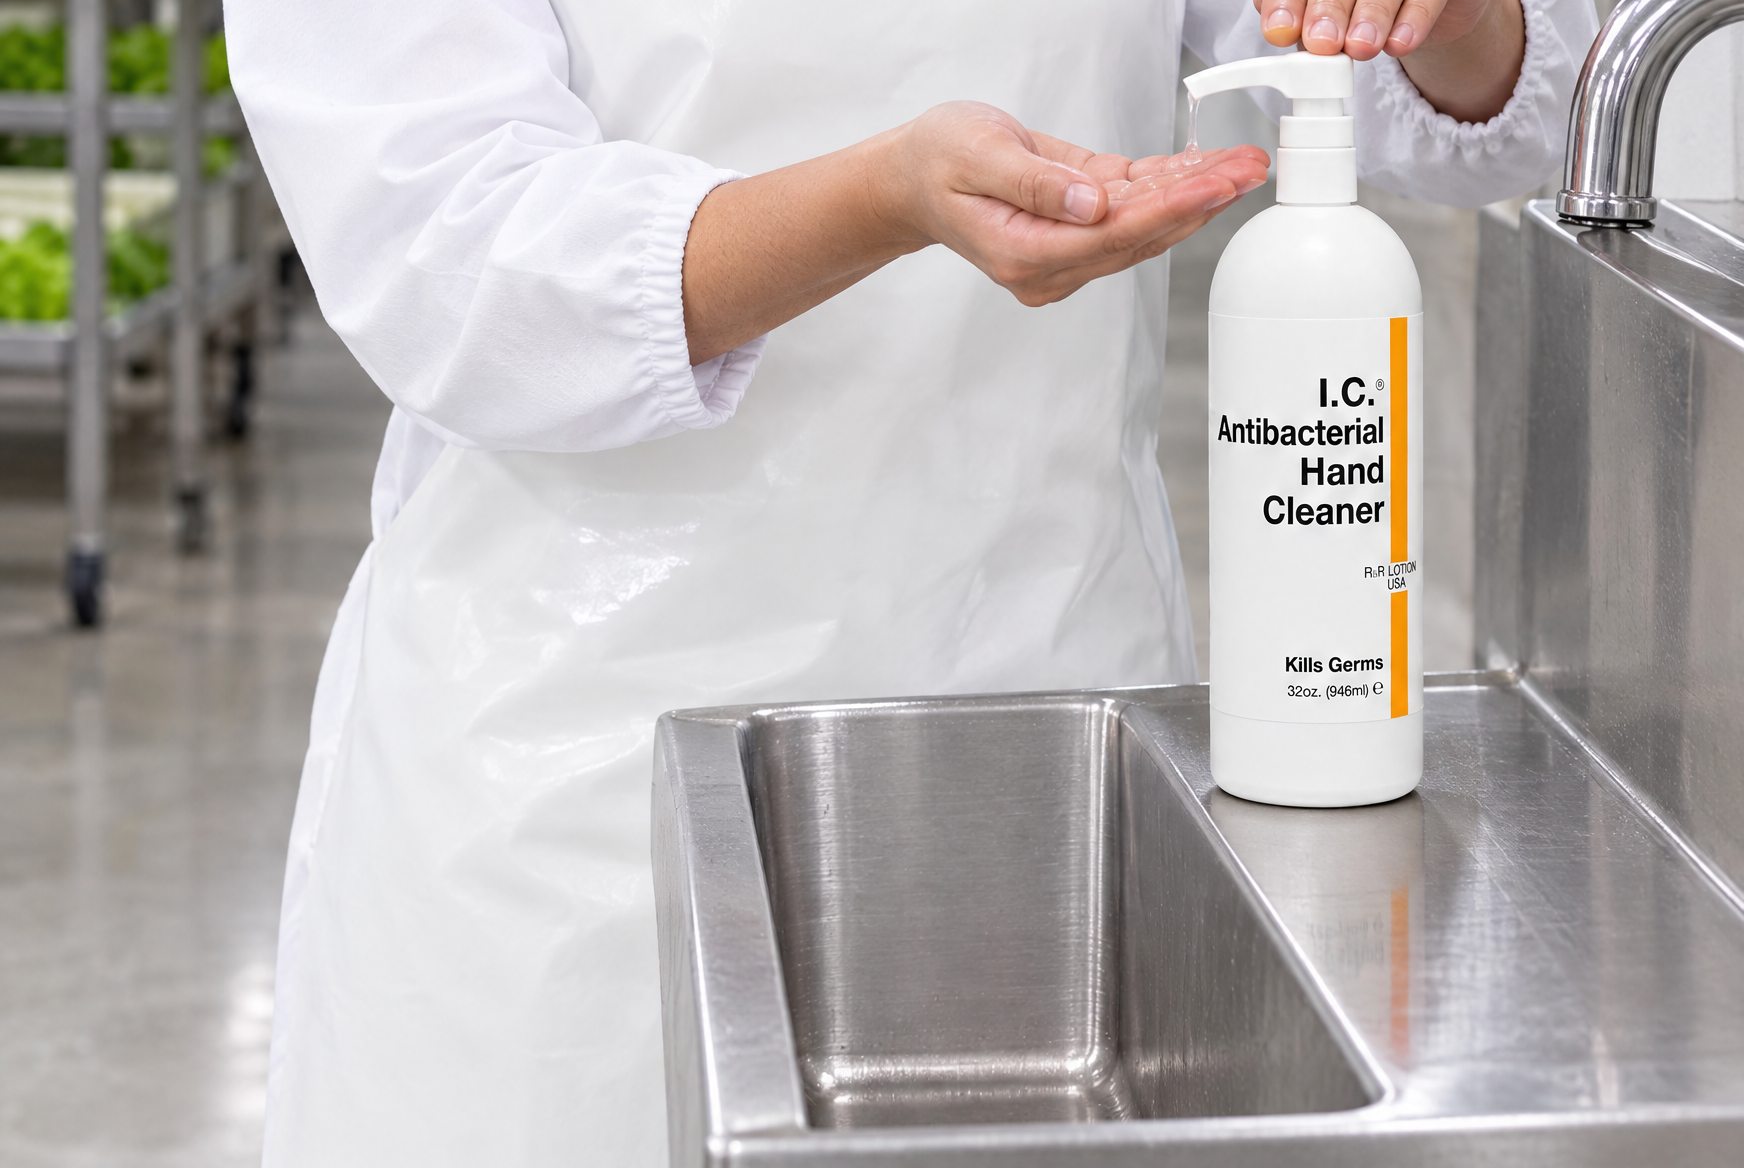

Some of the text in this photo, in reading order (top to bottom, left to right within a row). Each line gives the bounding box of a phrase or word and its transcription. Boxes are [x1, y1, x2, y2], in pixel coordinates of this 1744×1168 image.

[1217, 414, 1384, 447] Antibacterial
[1301, 455, 1384, 486] Hand
[1263, 494, 1385, 526] Cleaner
[1388, 560, 1417, 577] LOTION
[1387, 577, 1406, 590] USA
[1285, 656, 1384, 673] Kills Germs
[1287, 684, 1322, 698] 32oz.
[1326, 683, 1369, 700] (946ml)
